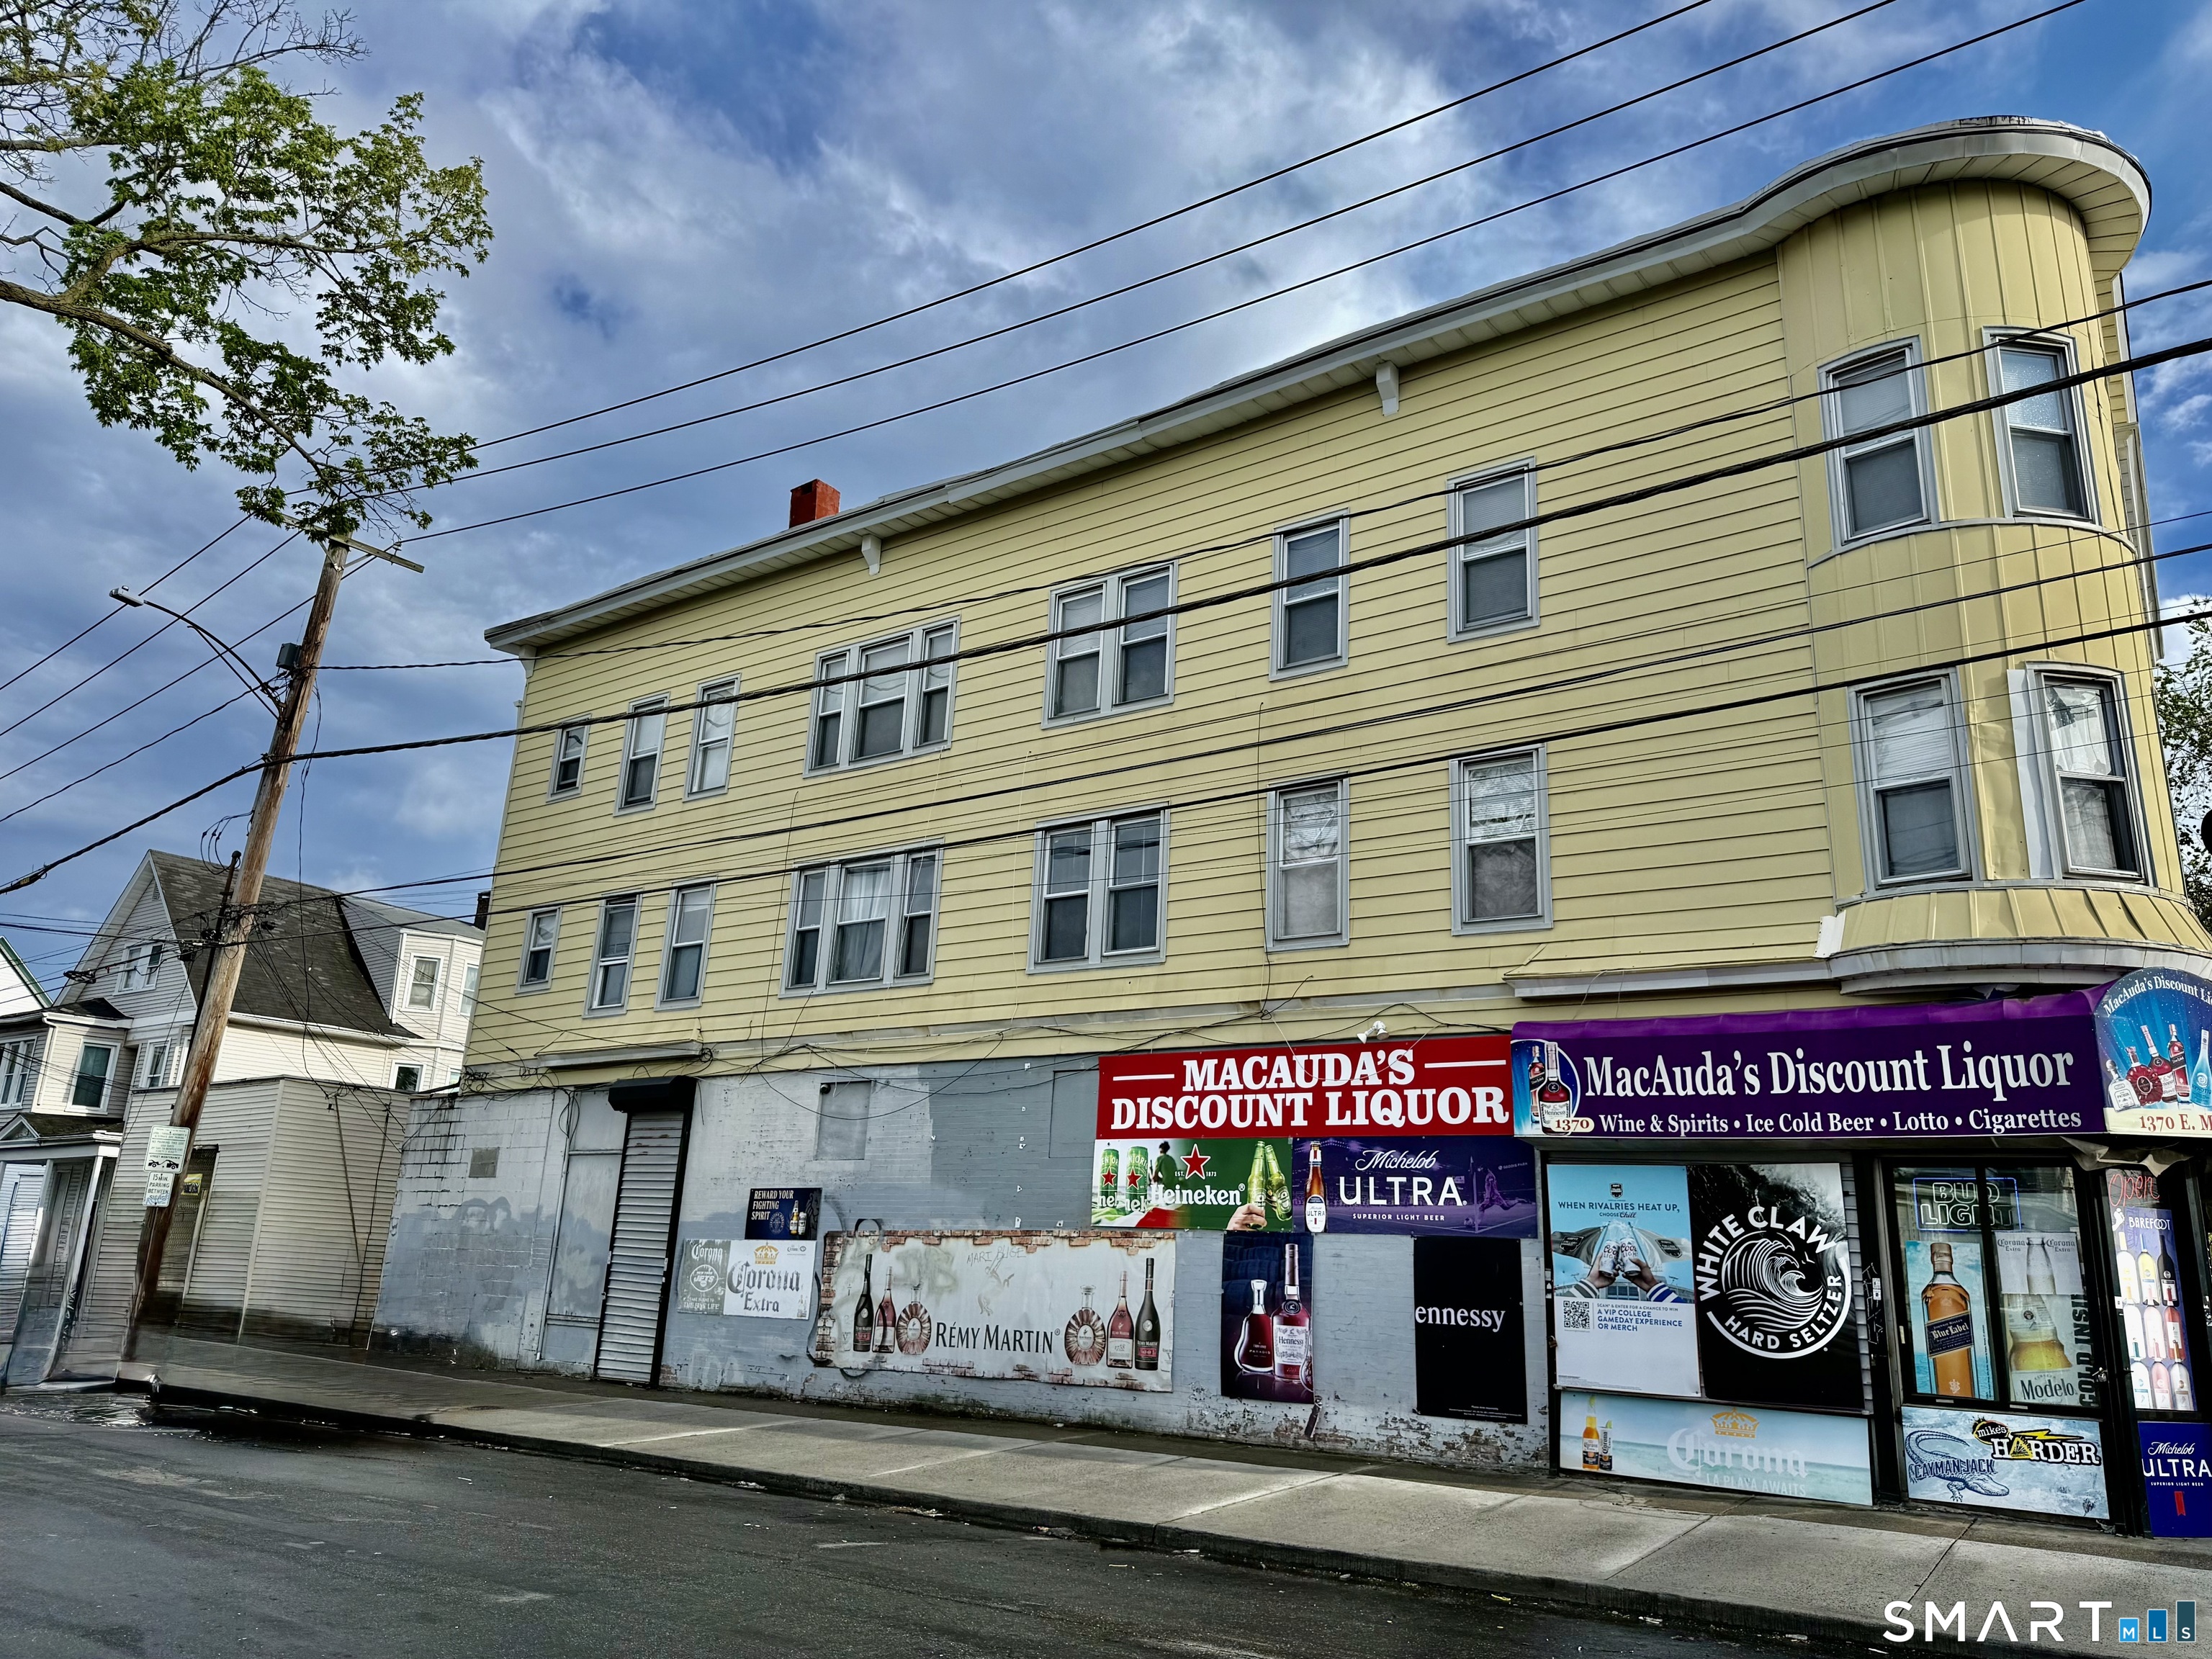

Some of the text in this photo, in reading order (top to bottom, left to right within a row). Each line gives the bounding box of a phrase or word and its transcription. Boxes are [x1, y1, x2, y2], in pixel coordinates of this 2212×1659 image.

[2103, 976, 2153, 1017] MacAuda's
[2153, 975, 2198, 998] Discount
[1182, 1048, 1415, 1092] MACAUDA'S
[1583, 1040, 2074, 1102] MacAuda's Discount Liquor
[1110, 1087, 1509, 1130] DISCOUNT LIQUOR
[1555, 1120, 1589, 1131] 1370
[1599, 1109, 2082, 1137] Wine & Spirits Ice Cold Beer Lotto Cigarettes
[2139, 1115, 2175, 1133] 1370
[2178, 1113, 2195, 1130] E.
[1355, 1150, 1439, 1171] Michelob
[754, 1190, 793, 1200] REWARD YOUR
[1339, 1176, 1464, 1206] ULTRA
[1932, 1182, 2000, 1203] BUD
[2108, 1174, 2160, 1207] Open
[751, 1211, 770, 1220] SPIRIT
[752, 1200, 780, 1210] FIGHTING
[1589, 1202, 1635, 1210] RIVALRIES
[1665, 1204, 1680, 1213] UP,
[1920, 1203, 2013, 1226] LIGHT
[1748, 1206, 1836, 1254] CLAW
[2128, 1216, 2170, 1230] BAREFOOT
[691, 1242, 723, 1264] Corona
[1997, 1238, 2025, 1247] Corona
[2046, 1238, 2075, 1247] Corona
[1696, 1213, 1745, 1301] WHITE
[727, 1261, 801, 1298] Corona
[744, 1291, 780, 1313] Extra
[1725, 1274, 1842, 1349] HARD SELTZER
[1635, 1318, 1683, 1327] EXPERIENCE
[1931, 1323, 1969, 1339] Blue Label
[935, 1321, 980, 1349] RÉMY
[1279, 1336, 1304, 1346] Hennessy
[2020, 1378, 2075, 1401] Modelo
[1977, 1424, 2008, 1438] mike's
[1666, 1427, 1809, 1478] Corona
[1990, 1437, 2100, 1465] HARDER
[2148, 1442, 2195, 1455] Michelob
[1915, 1457, 1995, 1479] CAYMAN JACK
[2141, 1458, 2212, 1478] ULTRA
[1707, 1473, 1807, 1496] LA PLAYA AWAITS
